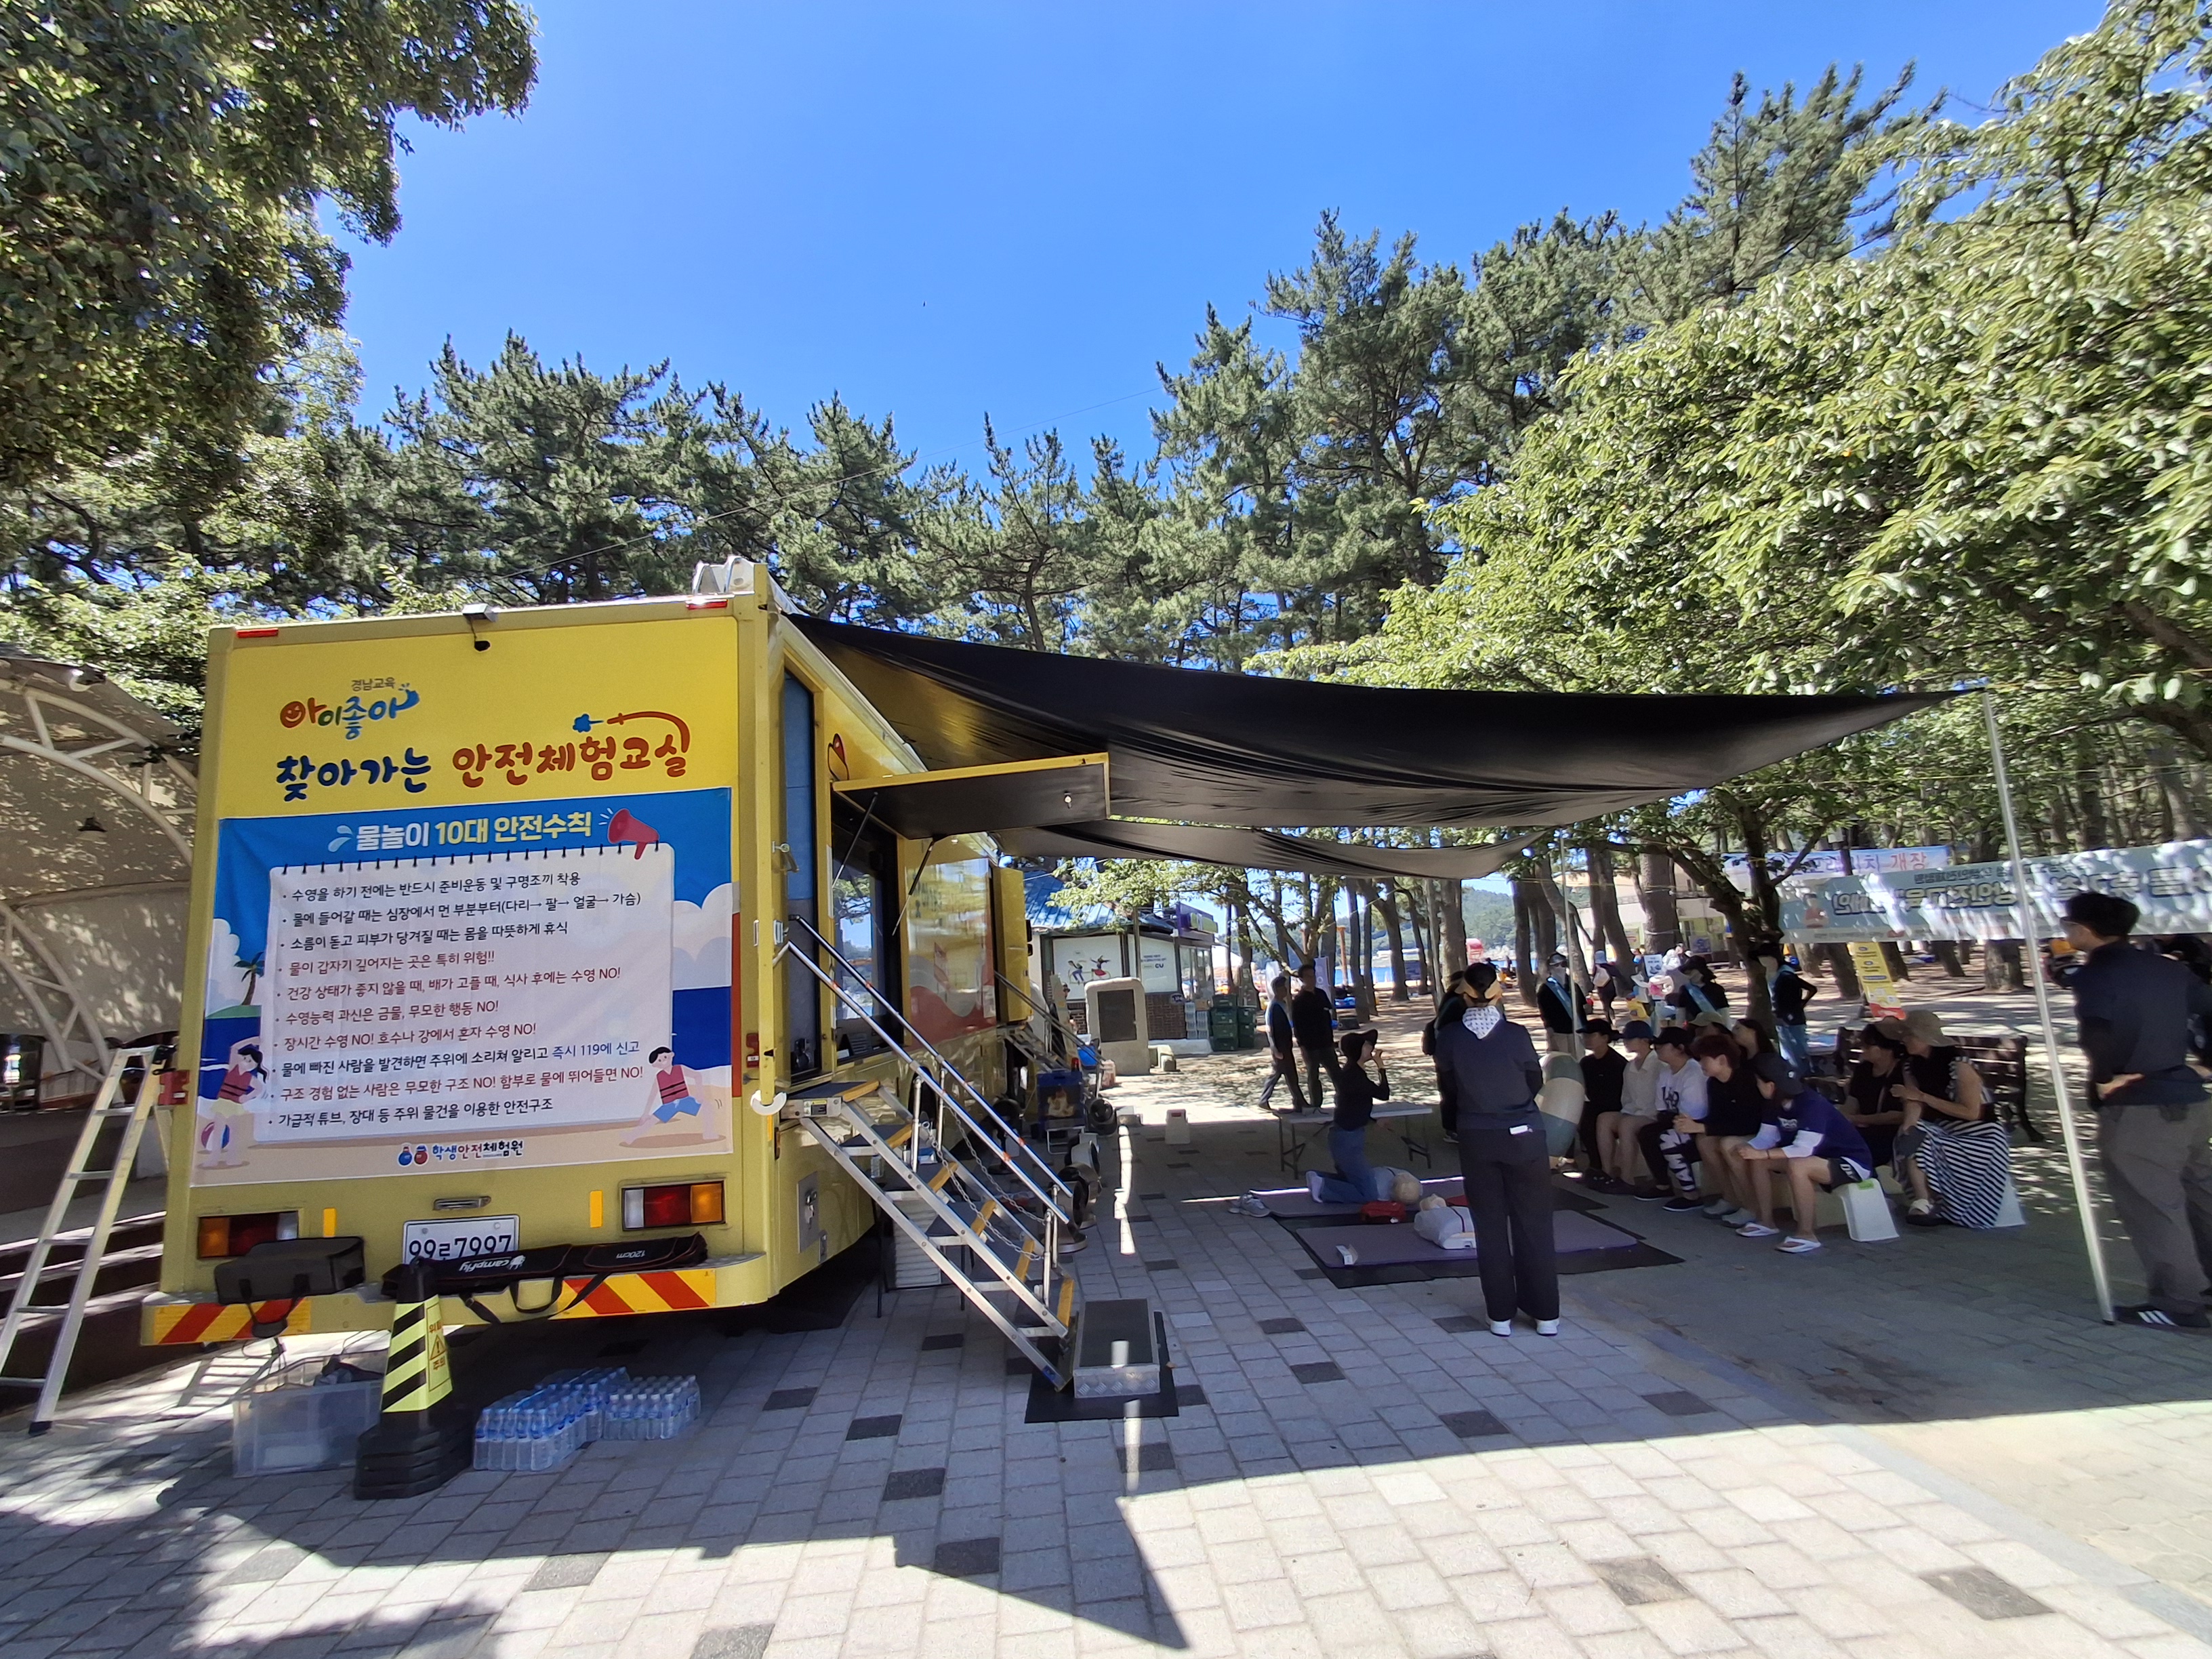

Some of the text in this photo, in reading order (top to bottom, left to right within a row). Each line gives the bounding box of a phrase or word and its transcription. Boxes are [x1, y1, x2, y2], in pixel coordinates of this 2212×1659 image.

[352, 677, 396, 692] 경남교육
[280, 690, 420, 740] 아이좋아
[276, 729, 691, 802] 찾아가는 안전체험교실
[356, 811, 592, 852] 물놀이 10대 안전수칙
[292, 872, 581, 901] 수영을 하기 전에는 반드시 준비운동 및 구명조끼 착용
[293, 913, 314, 926] 물에
[319, 911, 356, 925] 들어갈
[359, 909, 383, 922] 때는
[386, 906, 434, 922] 심장에서
[438, 905, 450, 917] 먼
[613, 892, 641, 906] 가슴)
[290, 922, 568, 951] 소름이 돋고 피부가 당겨질 때는 몸을 따뜻하게 휴식
[289, 950, 495, 976] 물이 갑자기 깊어지는 곳은 특히 위험!!
[287, 987, 312, 1001] 건강
[314, 984, 352, 999] 상태가
[356, 983, 379, 998] 좋지
[383, 981, 407, 996] 않을
[428, 977, 453, 991] 배가
[457, 976, 481, 991] 고플
[504, 973, 527, 987] 식사
[531, 971, 567, 985] 후에는
[571, 968, 595, 983] 수영
[598, 967, 621, 979] NO!
[285, 1010, 334, 1025] 수영능력
[338, 1008, 374, 1023] 과신은
[409, 1004, 446, 1019] 무모한
[449, 1002, 473, 1017] 행동
[476, 1000, 499, 1012] NO!
[284, 1023, 537, 1051] 장시간 수영 NO! 호수나 강에서 혼자 수영 NO!
[281, 1041, 640, 1077] 물에 빠진 사람을 발견하면 주위에 소리쳐 알리고 즉시 119에 신고
[280, 1066, 643, 1101] 구조 경험 없는 사람은 무모한 구조 NO! 함부로 물에 뛰어들면 NO!
[278, 1113, 314, 1128] 가급적
[349, 1109, 375, 1124] 장대
[377, 1108, 390, 1123] 등
[393, 1106, 419, 1122] 주위
[423, 1103, 460, 1120] 물건을
[464, 1101, 500, 1117] 이용한
[504, 1098, 554, 1115] 안전구조
[432, 1140, 524, 1160] 학생안전체험원
